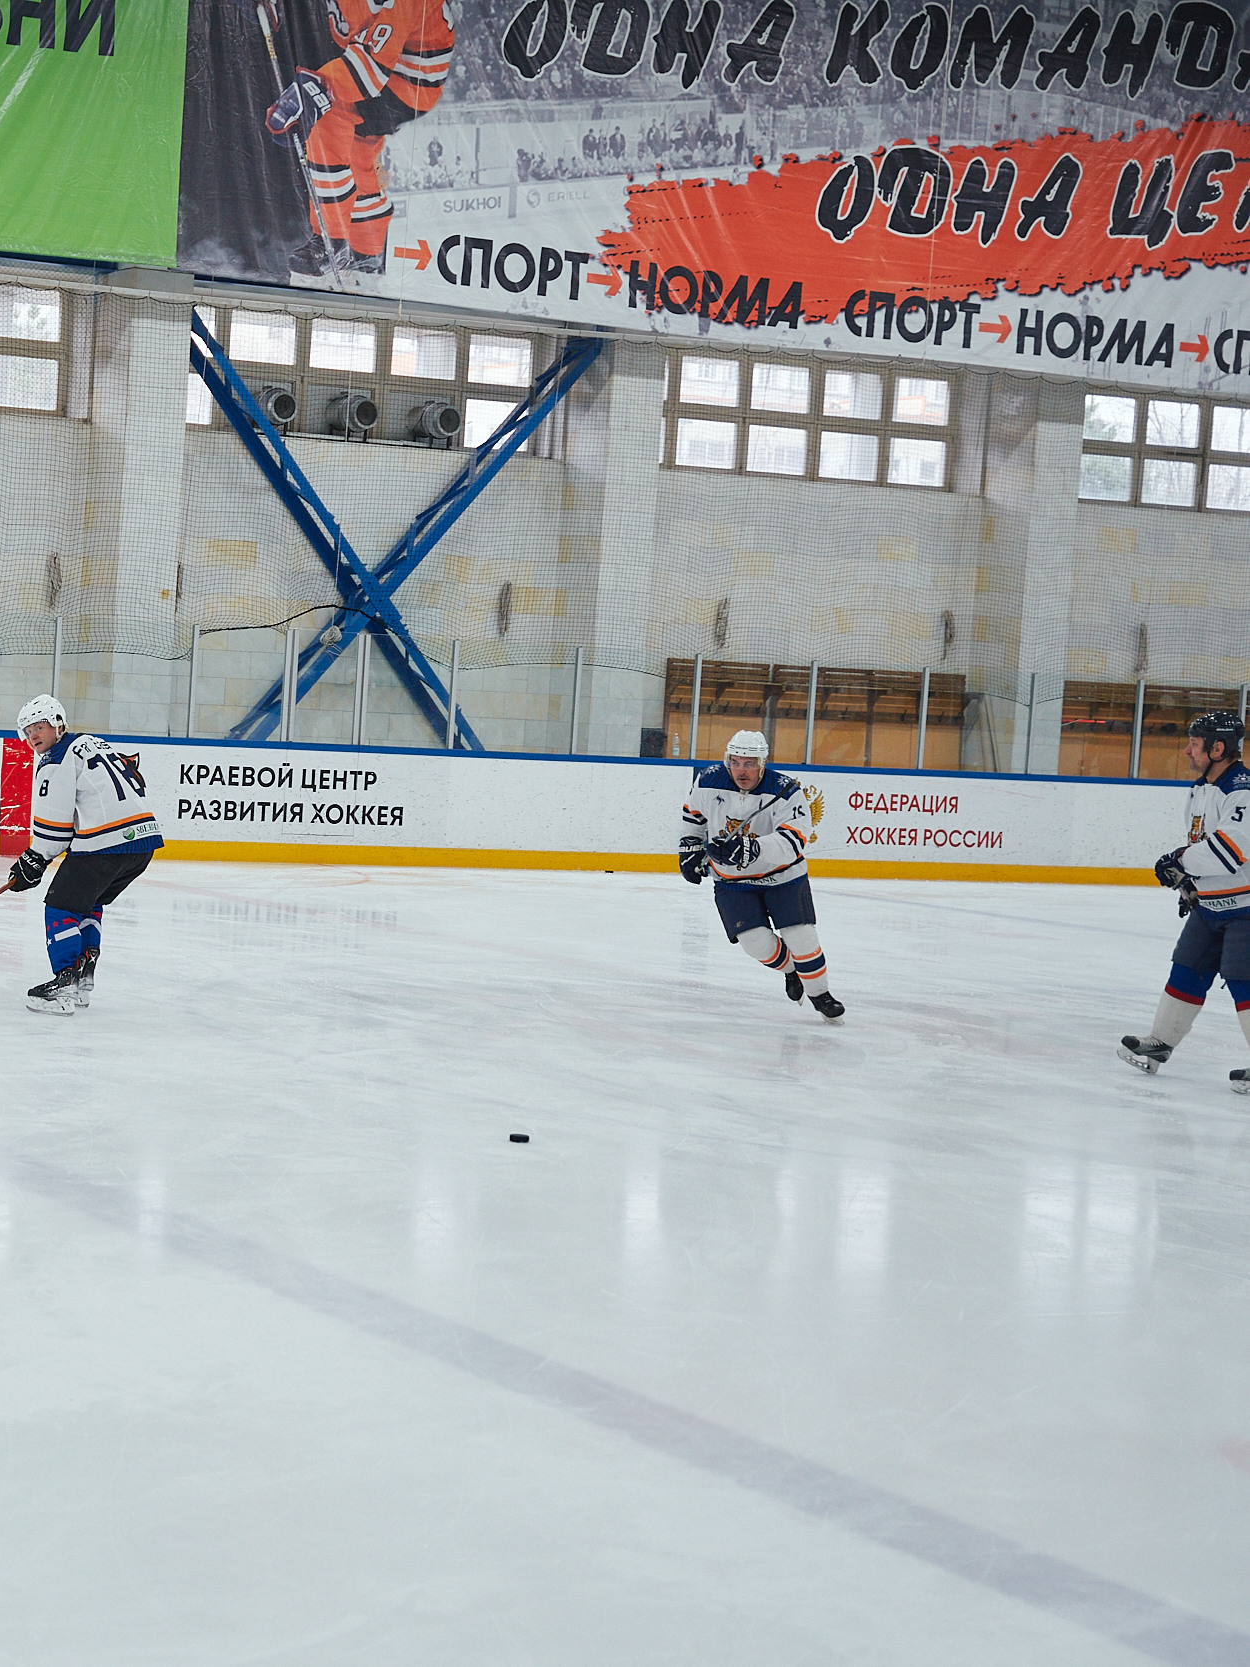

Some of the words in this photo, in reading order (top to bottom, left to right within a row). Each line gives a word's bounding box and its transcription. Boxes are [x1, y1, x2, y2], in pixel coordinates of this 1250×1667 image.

[501, 0, 796, 90] ОДНА
[824, 0, 1250, 99] КОМАНД
[443, 196, 502, 214] SUKHOI
[815, 145, 1083, 248] ОДНА
[437, 234, 590, 301] СПОРТ
[628, 260, 803, 330] НОРМА
[845, 289, 981, 349] СПОРТ
[1016, 307, 1175, 369] НОРМА
[179, 763, 294, 789] КРАЕВОЙ
[301, 768, 378, 793] ЦЕНТР
[178, 799, 304, 823] РАЗВИТИЯ
[310, 803, 404, 827] ХОККЕЯ
[848, 791, 959, 816] ФЕДЕРАЦИЯ
[1231, 806, 1246, 822] 5
[846, 826, 918, 846] ХОККЕЯ
[923, 829, 1003, 849] РОССИИ
